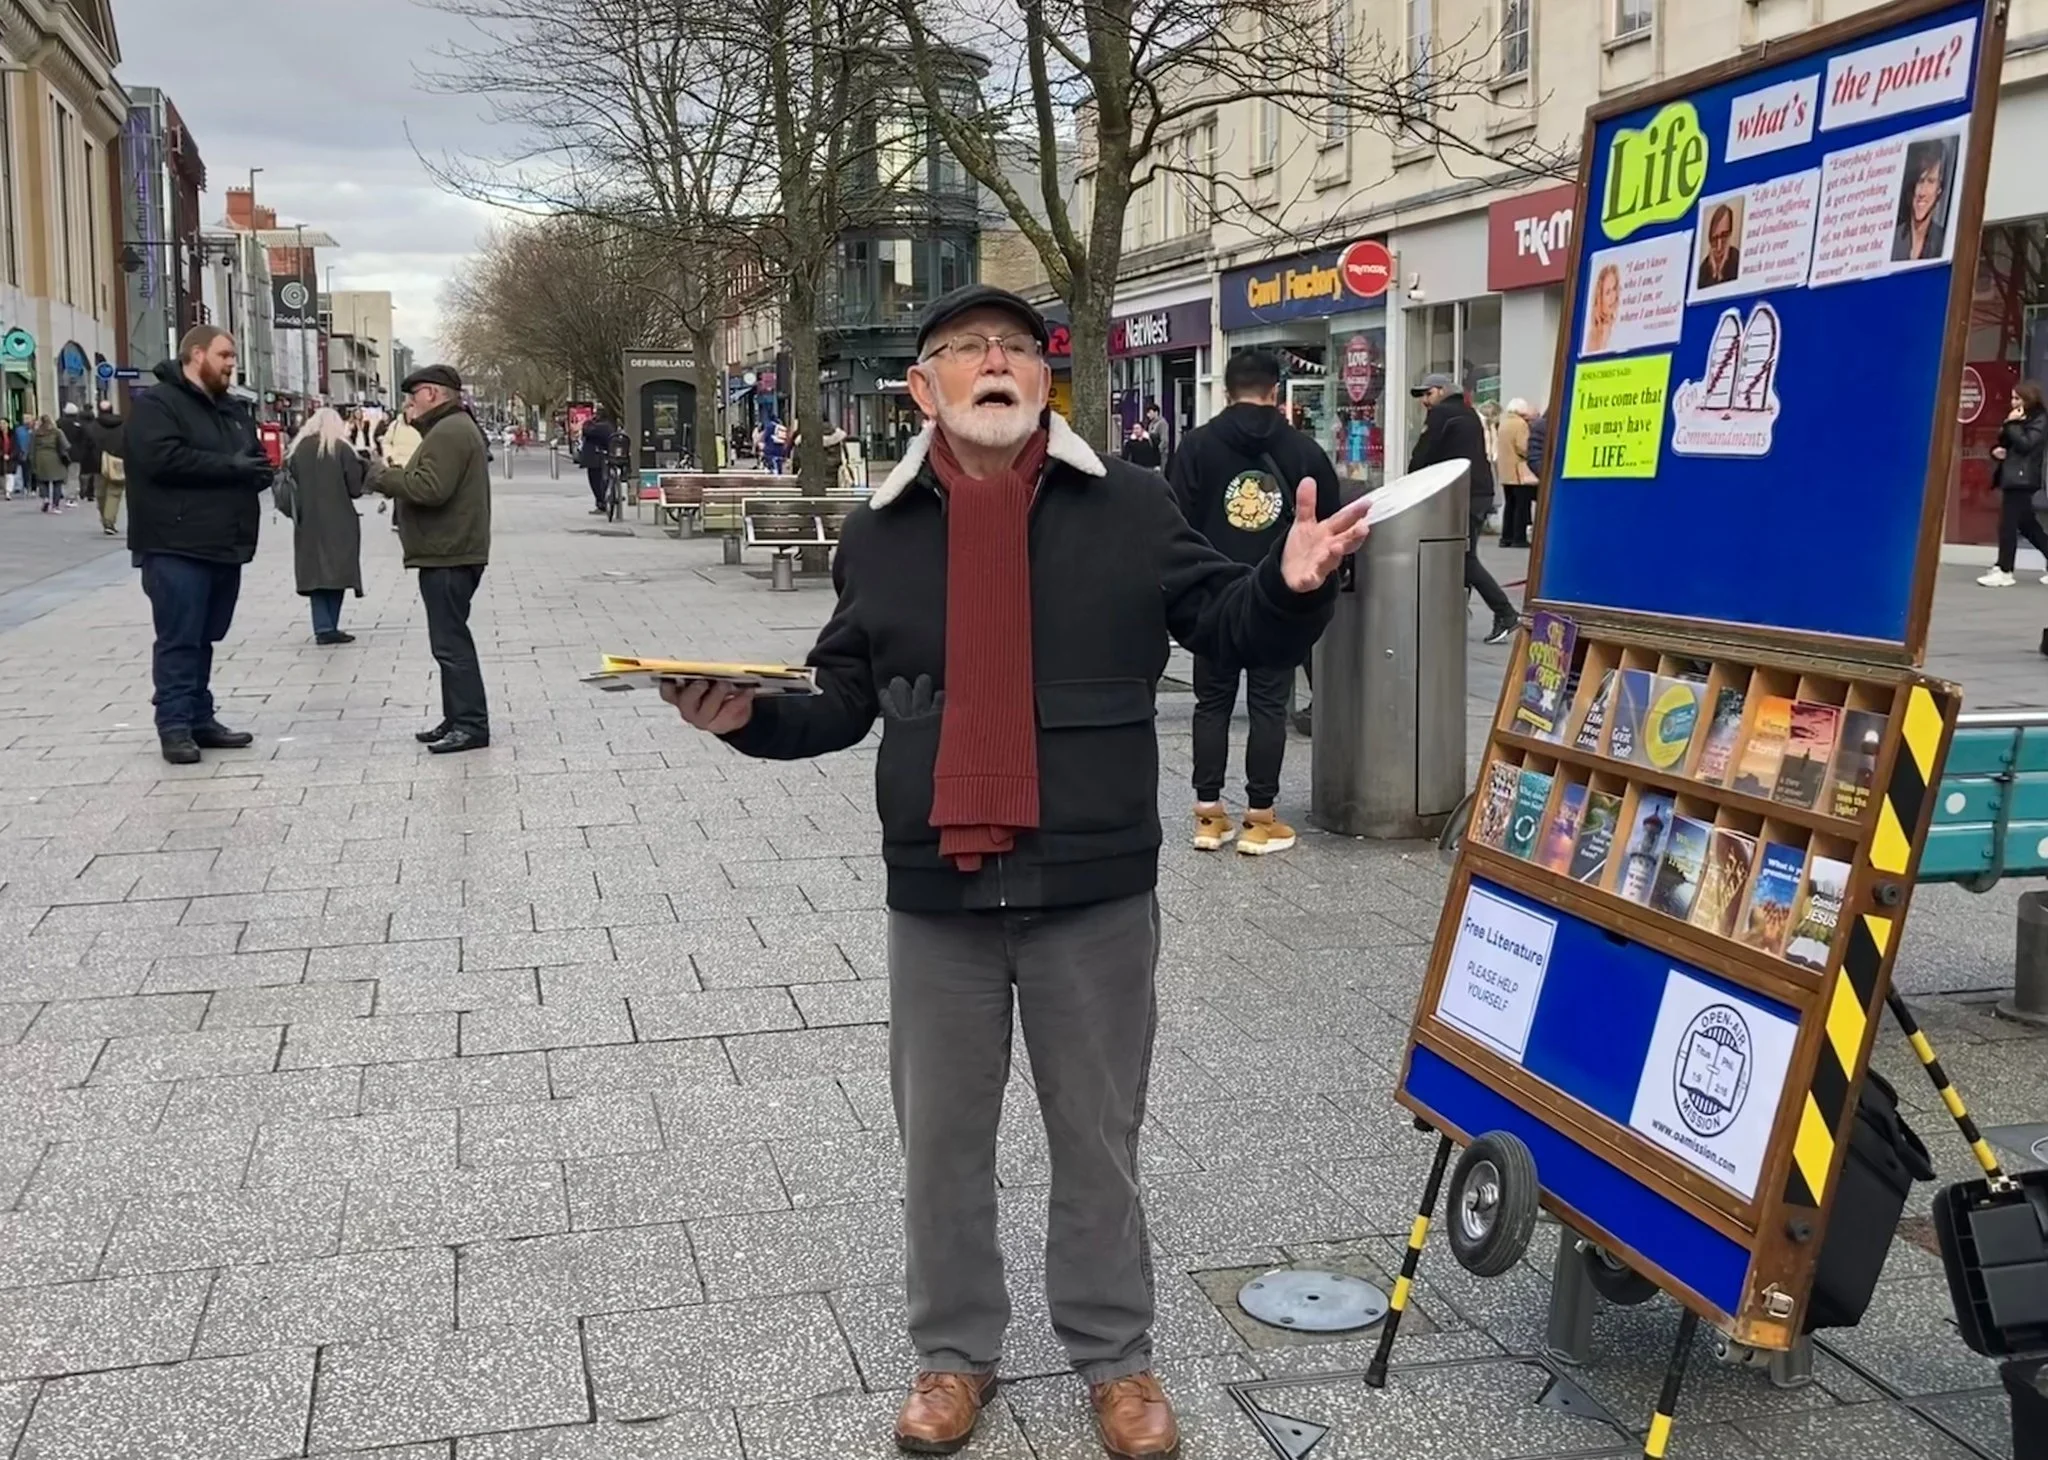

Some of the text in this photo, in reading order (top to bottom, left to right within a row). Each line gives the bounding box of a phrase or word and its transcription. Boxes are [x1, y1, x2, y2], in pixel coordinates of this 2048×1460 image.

[1832, 35, 1963, 107] the point?
[1737, 91, 1808, 142] what's
[1602, 115, 1703, 223] Life
[1847, 184, 1888, 204] everything
[1248, 264, 1342, 308] Card Factory
[1125, 313, 1169, 348] NatWest
[1587, 391, 1610, 409] have
[1611, 391, 1639, 407] come
[1640, 386, 1662, 405] that
[1582, 415, 1652, 441] you may have
[1225, 476, 1240, 500] NEW
[1577, 734, 1599, 747] Livin
[1768, 858, 1788, 871] What
[1788, 863, 1796, 873] is
[1805, 909, 1838, 928] JESUS
[1811, 894, 1842, 912] Consid
[1464, 916, 1544, 967] Free Literature
[1466, 960, 1519, 994] PLEASE HELP
[1468, 982, 1510, 1012] YOURSELF
[1701, 1011, 1747, 1048] OPEN-AIR
[1680, 1098, 1722, 1131] MISSION
[1651, 1118, 1737, 1175] www.oamission.com
